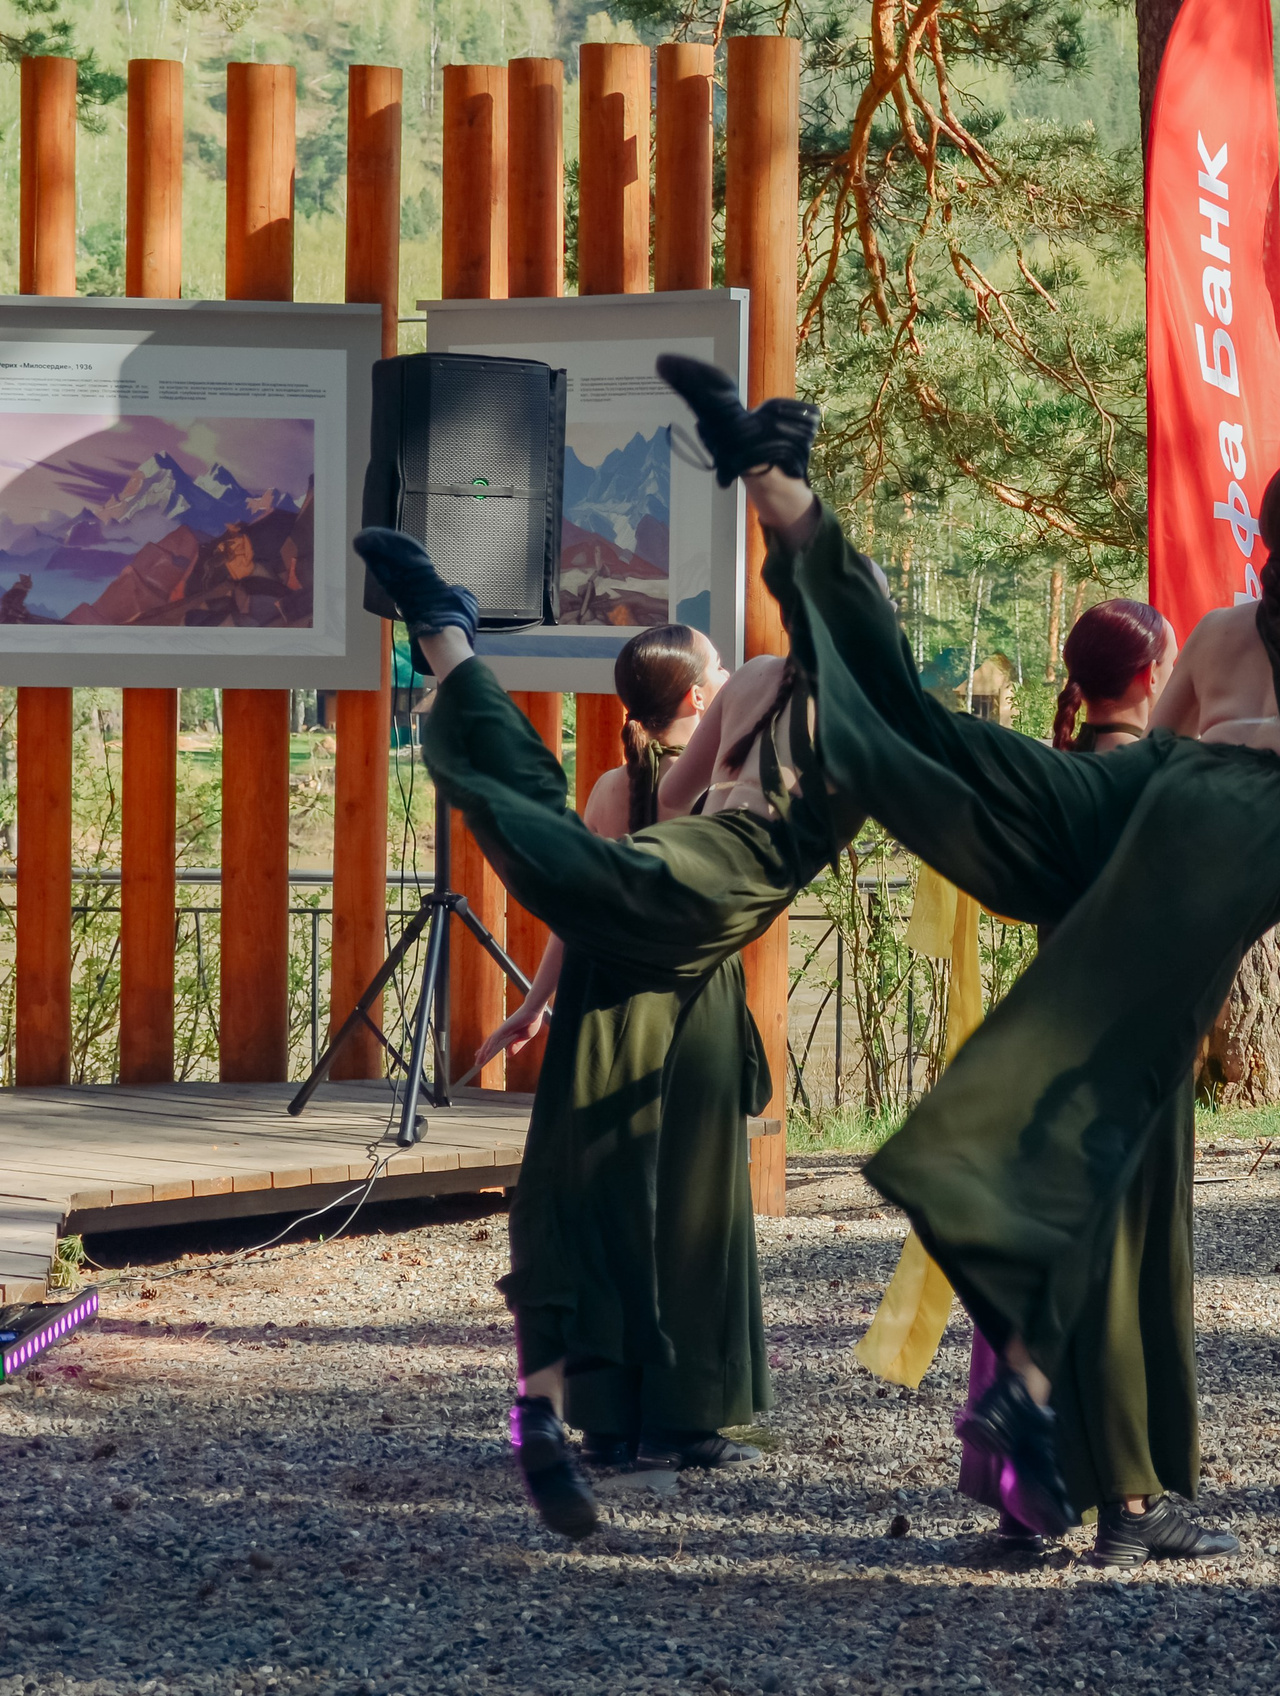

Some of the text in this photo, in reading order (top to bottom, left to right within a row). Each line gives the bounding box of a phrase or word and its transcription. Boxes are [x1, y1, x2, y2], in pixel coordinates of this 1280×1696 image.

[75, 363, 93, 371] 1936
[1195, 129, 1263, 608] ьфа Банк
